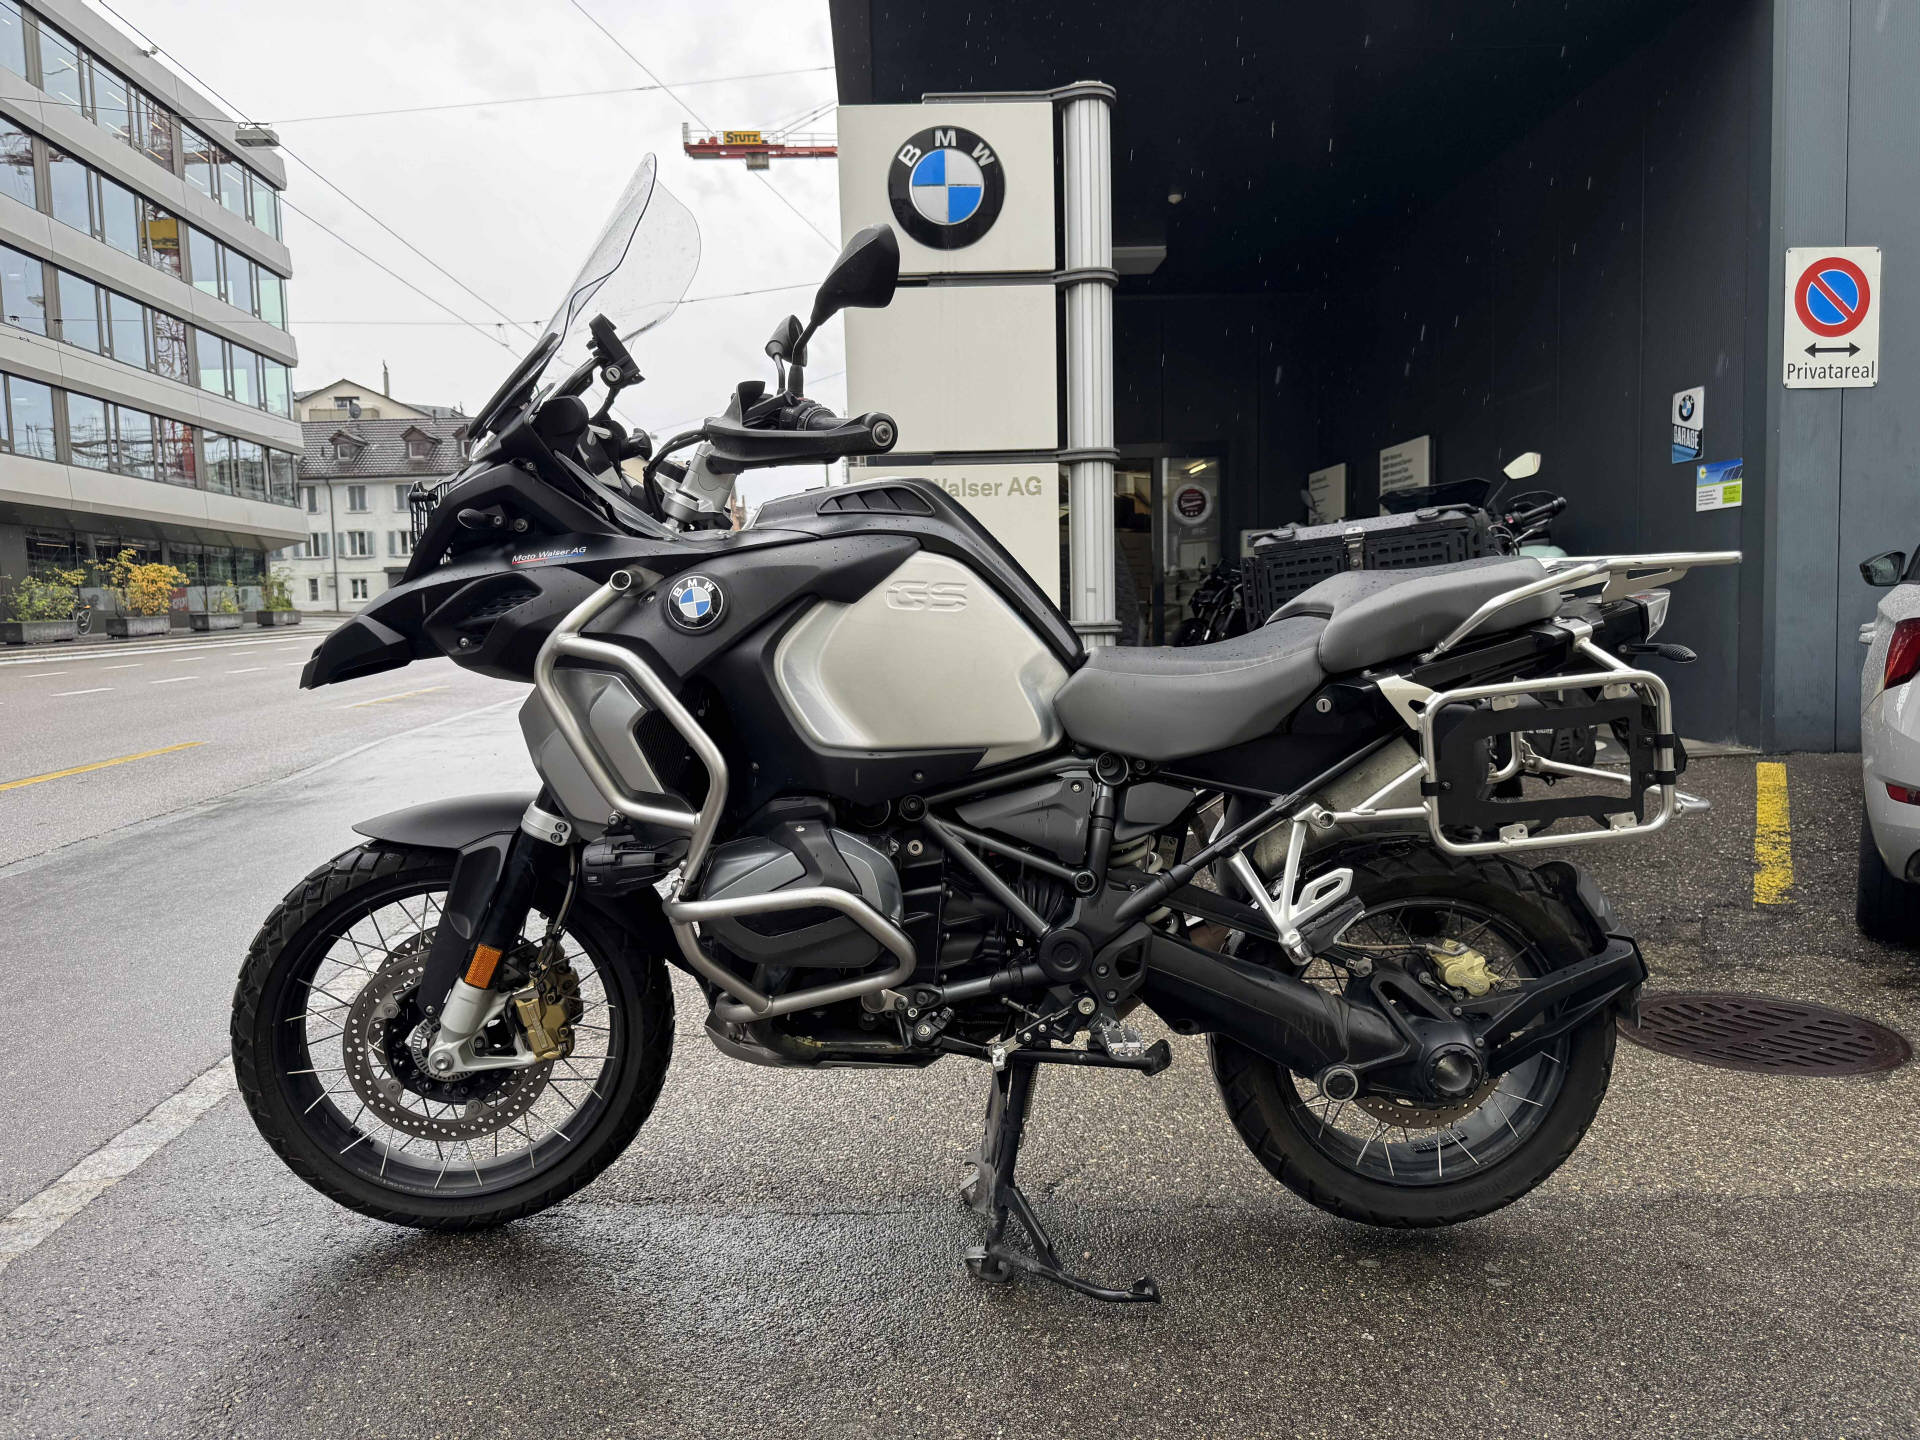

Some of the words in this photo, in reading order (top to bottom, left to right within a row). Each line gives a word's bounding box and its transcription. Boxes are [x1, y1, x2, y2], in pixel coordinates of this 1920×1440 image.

[726, 131, 759, 143] STUTZ
[898, 129, 995, 167] BMW
[1787, 360, 1875, 380] Privatareal
[1673, 425, 1700, 450] GARAGE
[1007, 475, 1042, 497] AG
[511, 554, 536, 562] Moto
[538, 548, 570, 558] Walser
[571, 546, 587, 554] AG
[673, 578, 715, 597] BMW
[886, 580, 967, 612] GS
